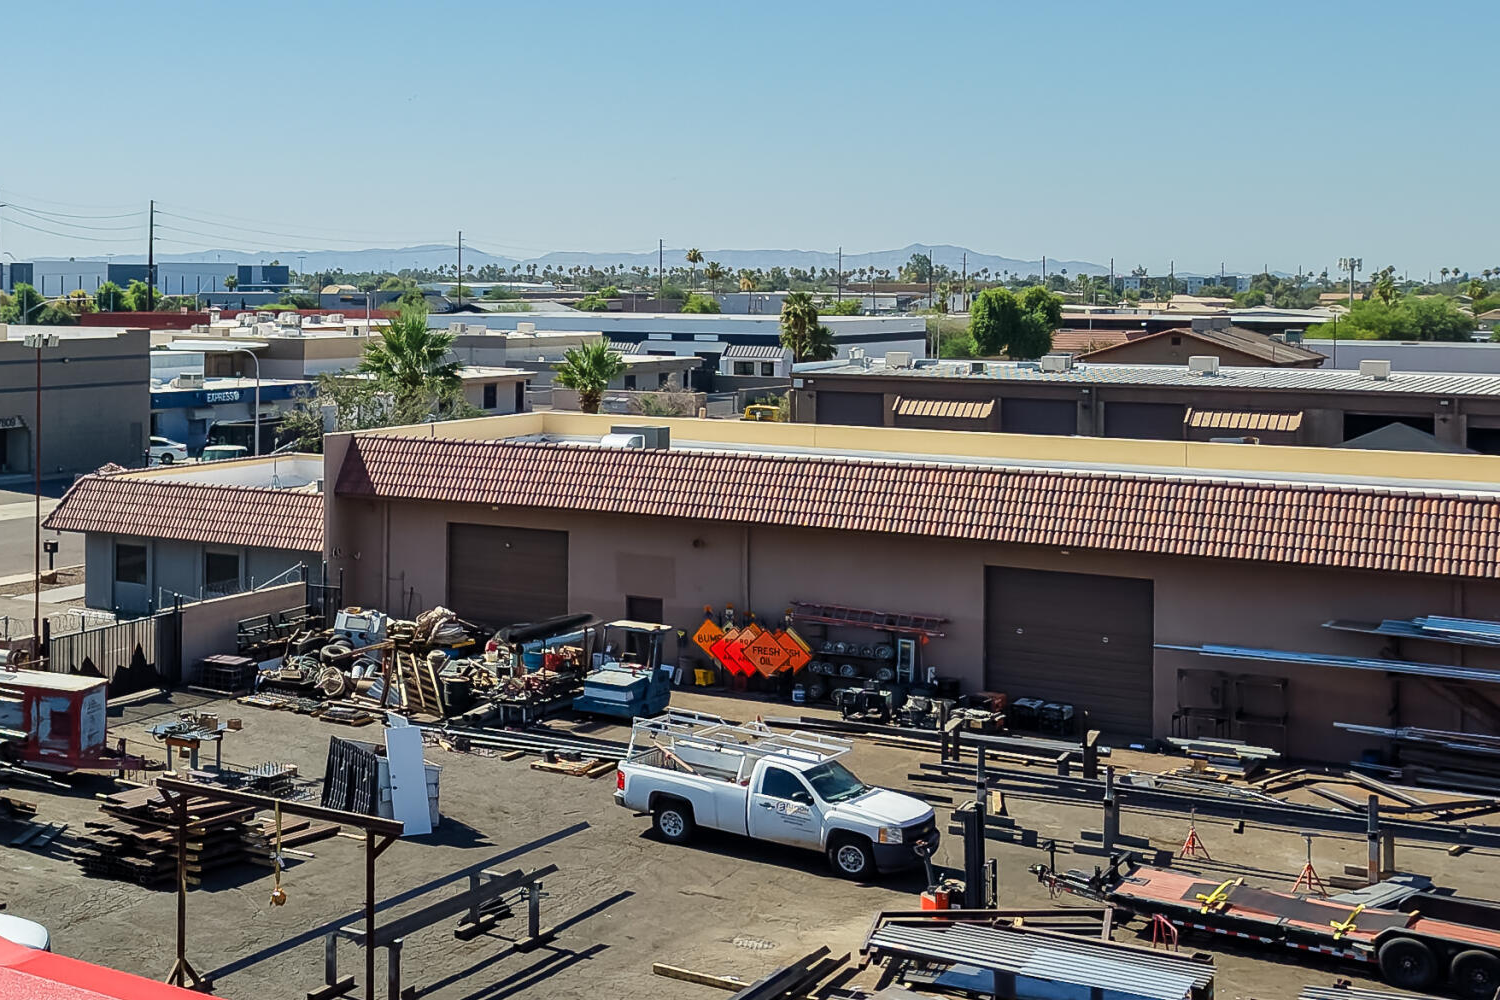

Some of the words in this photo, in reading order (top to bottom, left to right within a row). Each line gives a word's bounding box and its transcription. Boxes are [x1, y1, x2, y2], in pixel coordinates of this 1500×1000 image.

[207, 392, 235, 402] EXPRESS
[753, 646, 780, 656] FRESH
[760, 657, 773, 666] OIL
